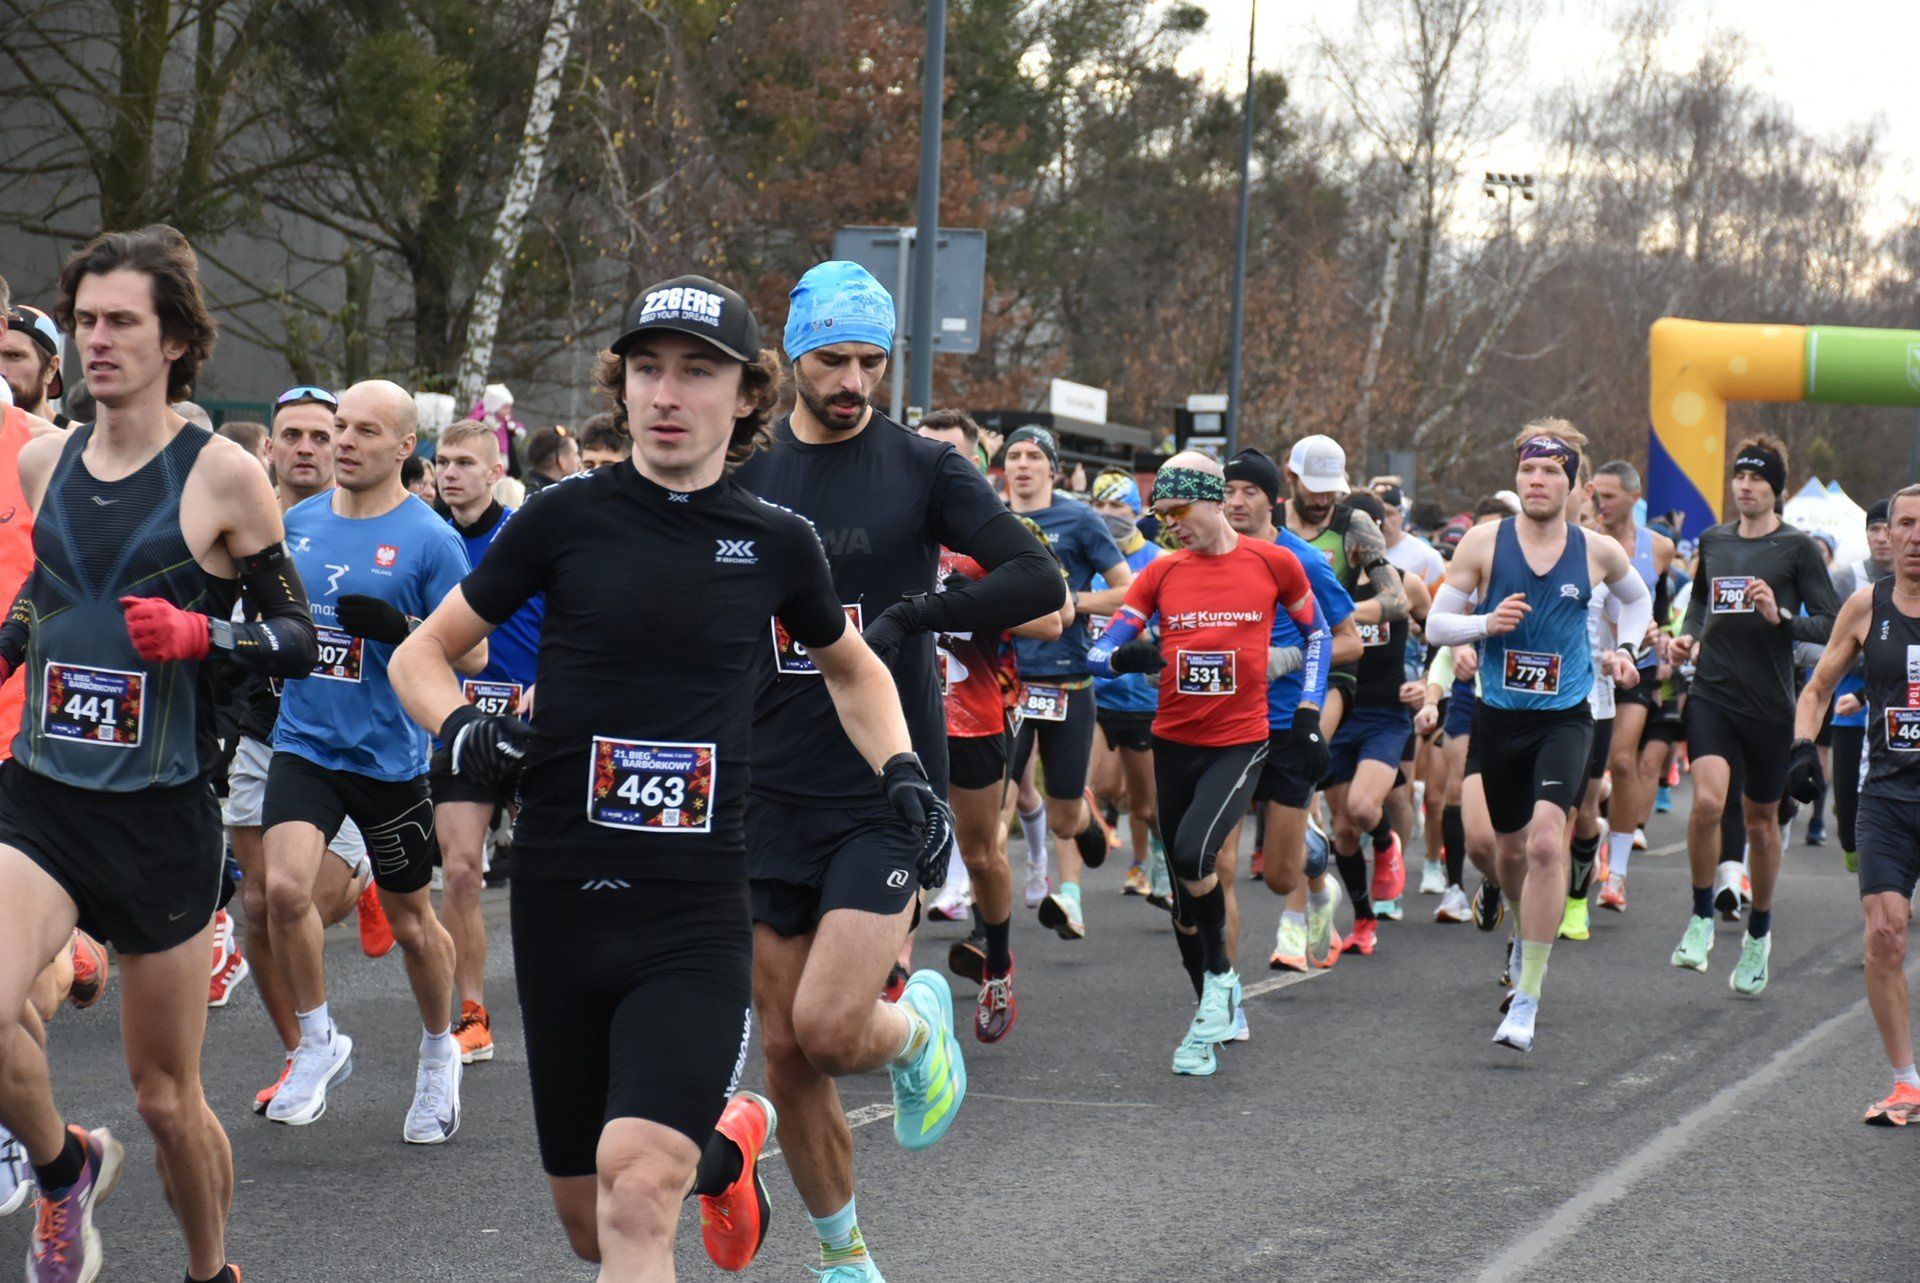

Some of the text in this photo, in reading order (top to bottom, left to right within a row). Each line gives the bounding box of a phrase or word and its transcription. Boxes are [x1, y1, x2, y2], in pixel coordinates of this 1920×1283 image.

[641, 287, 722, 317] 226ERS
[657, 310, 680, 319] YOUR
[681, 311, 719, 327] DREAMS
[371, 568, 393, 577] POLAND
[1719, 589, 1745, 603] 780
[1198, 611, 1263, 622] Kurowski
[1216, 620, 1238, 628] Britain
[1189, 667, 1221, 683] 531
[1516, 665, 1547, 682] 779
[64, 694, 117, 725] 441
[476, 697, 509, 715] 457
[614, 749, 627, 759] 21.
[628, 752, 651, 761] BIEG
[622, 759, 692, 770] BARBÓRKOWY
[617, 775, 685, 807] 463
